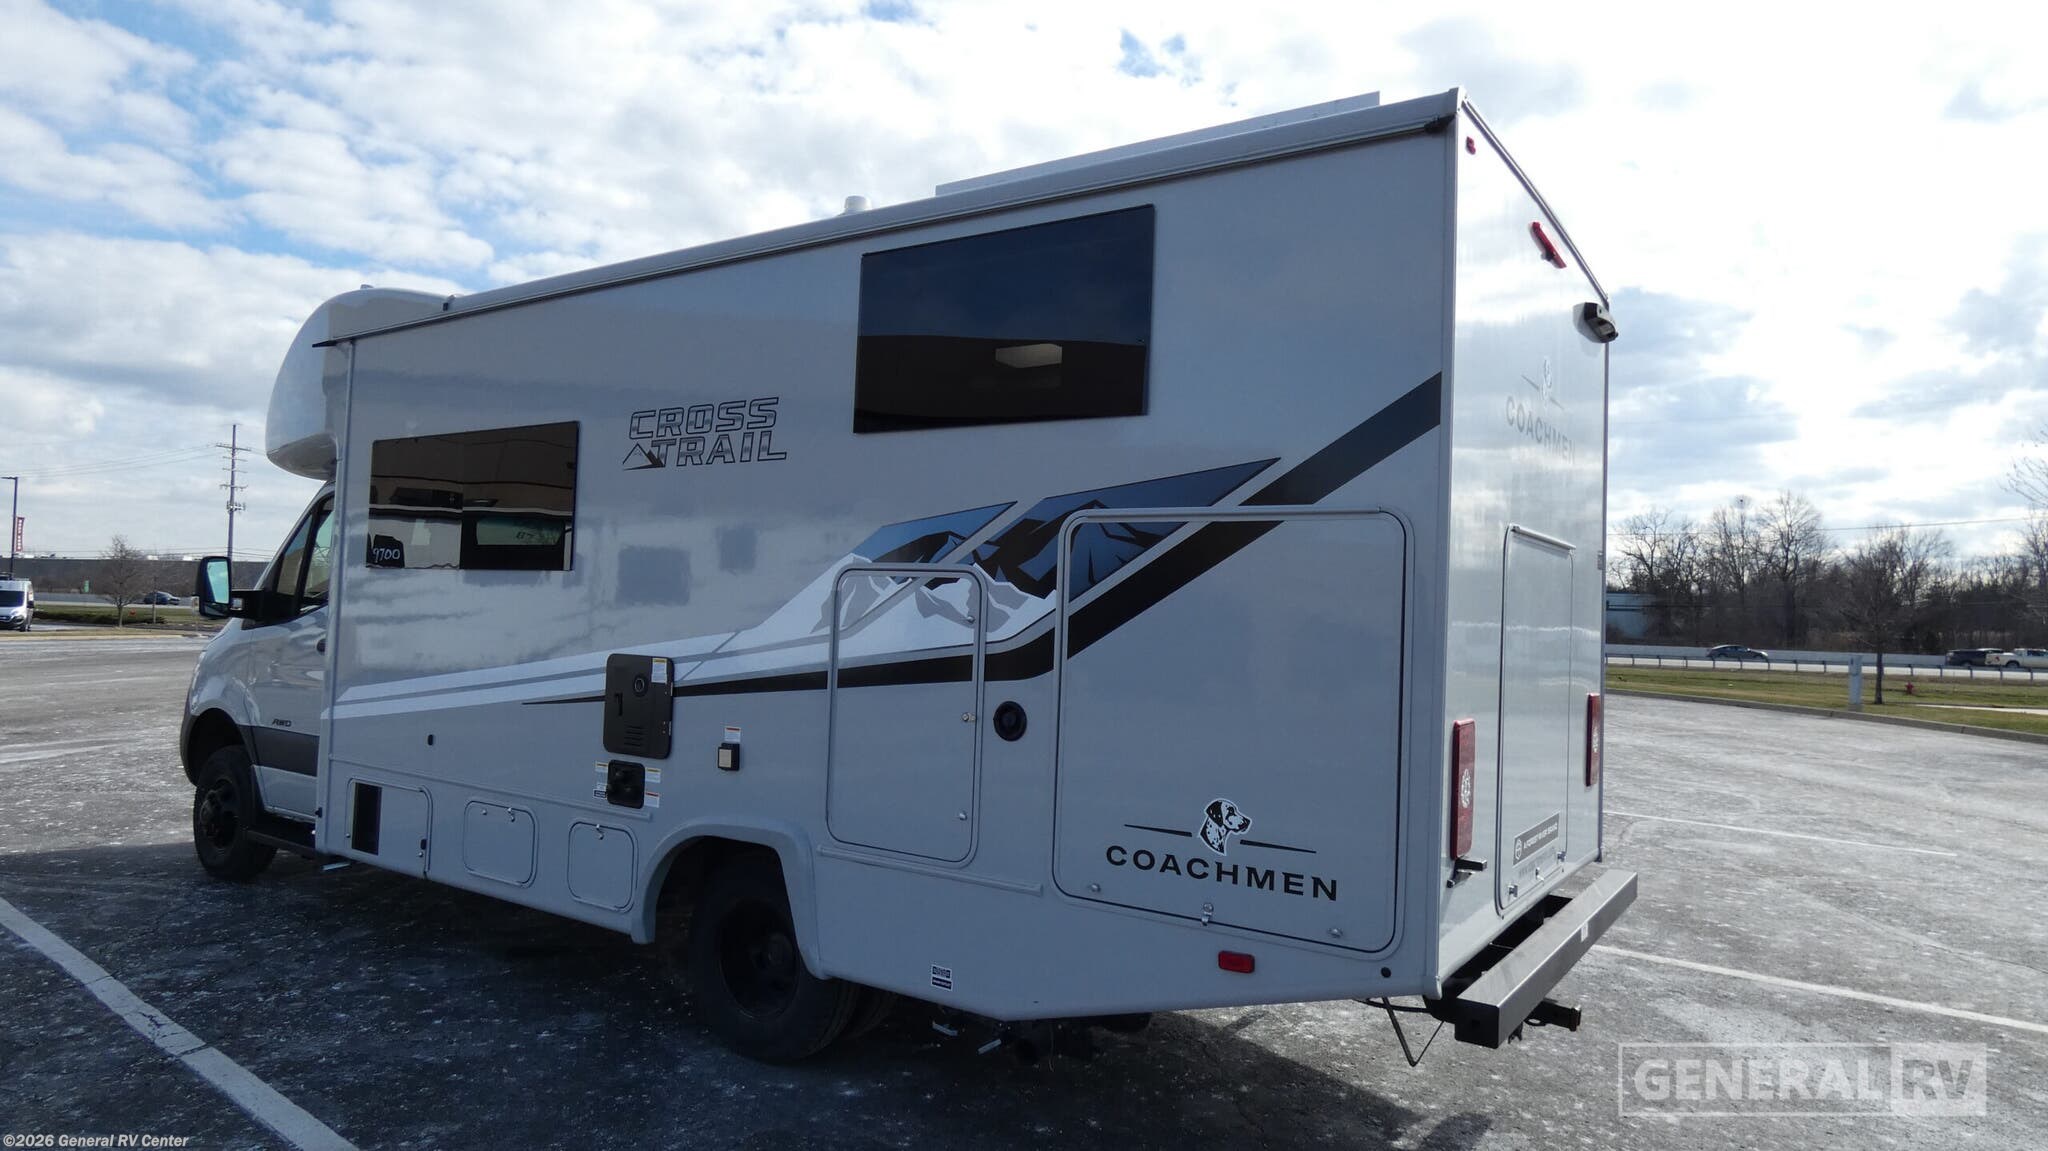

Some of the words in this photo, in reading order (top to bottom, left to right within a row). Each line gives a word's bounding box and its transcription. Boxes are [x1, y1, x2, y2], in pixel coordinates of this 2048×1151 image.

[629, 397, 780, 440] CROSS
[1505, 395, 1576, 464] COACHMEN
[651, 430, 788, 468] TRAIL
[373, 547, 401, 563] 9700
[1106, 845, 1337, 901] COACHMEN
